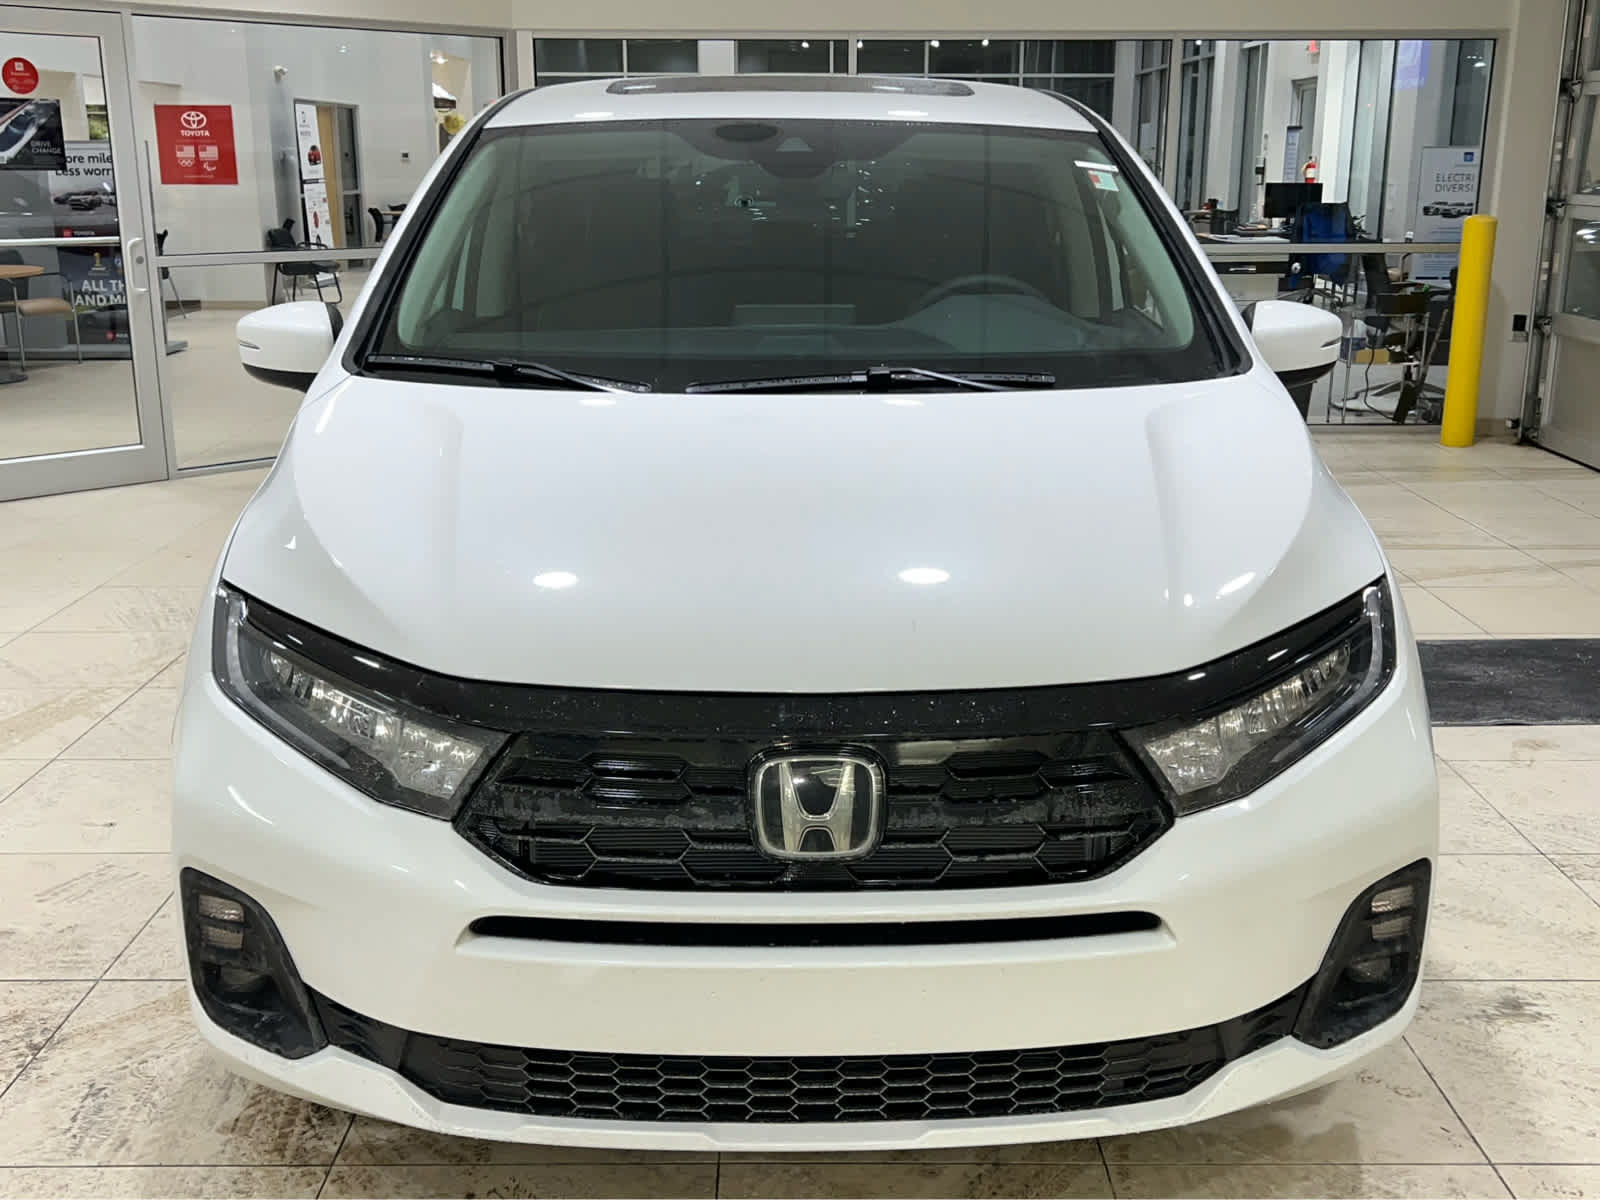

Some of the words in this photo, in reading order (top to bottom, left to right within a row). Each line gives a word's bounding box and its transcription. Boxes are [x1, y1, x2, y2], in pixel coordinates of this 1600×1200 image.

[180, 129, 210, 137] TOYOTA
[65, 155, 85, 163] ore
[81, 279, 107, 292] ALL
[74, 294, 105, 306] AND
